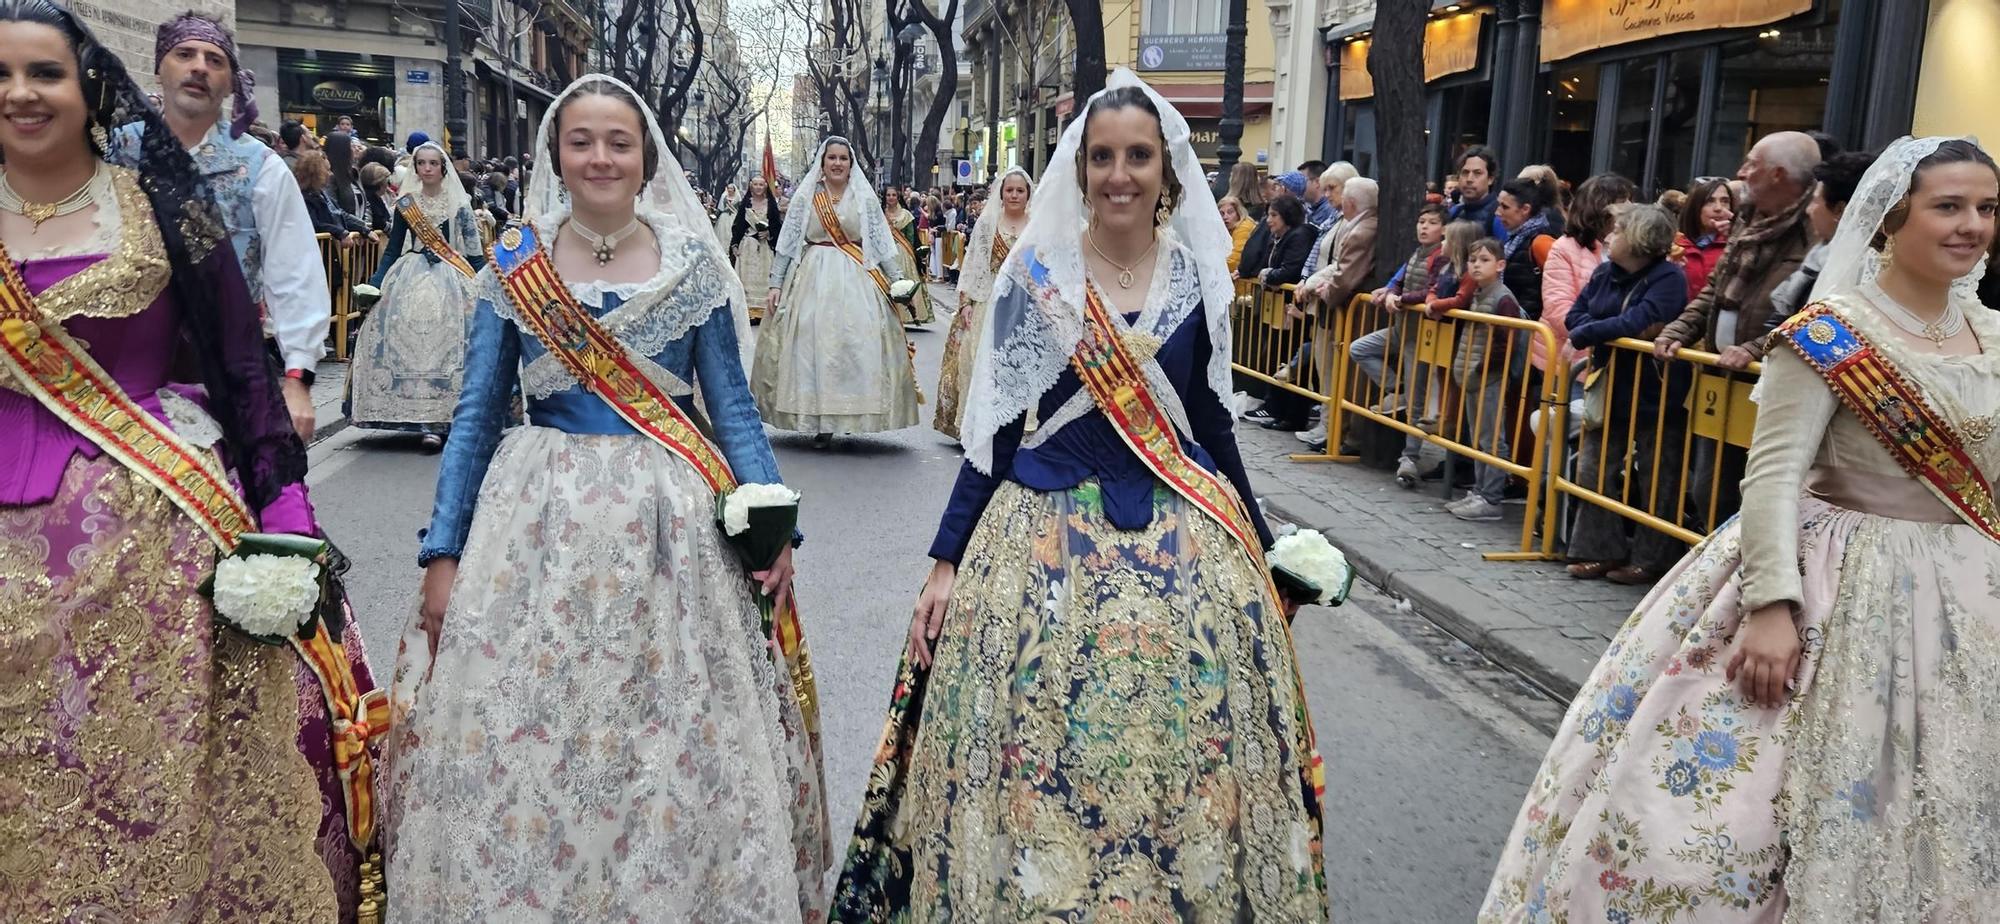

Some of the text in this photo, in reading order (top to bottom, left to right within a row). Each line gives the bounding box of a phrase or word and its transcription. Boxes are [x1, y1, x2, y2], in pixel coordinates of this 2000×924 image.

[1144, 35, 1229, 45] GUERRERO HERNAND
[313, 88, 362, 100] GRANIER
